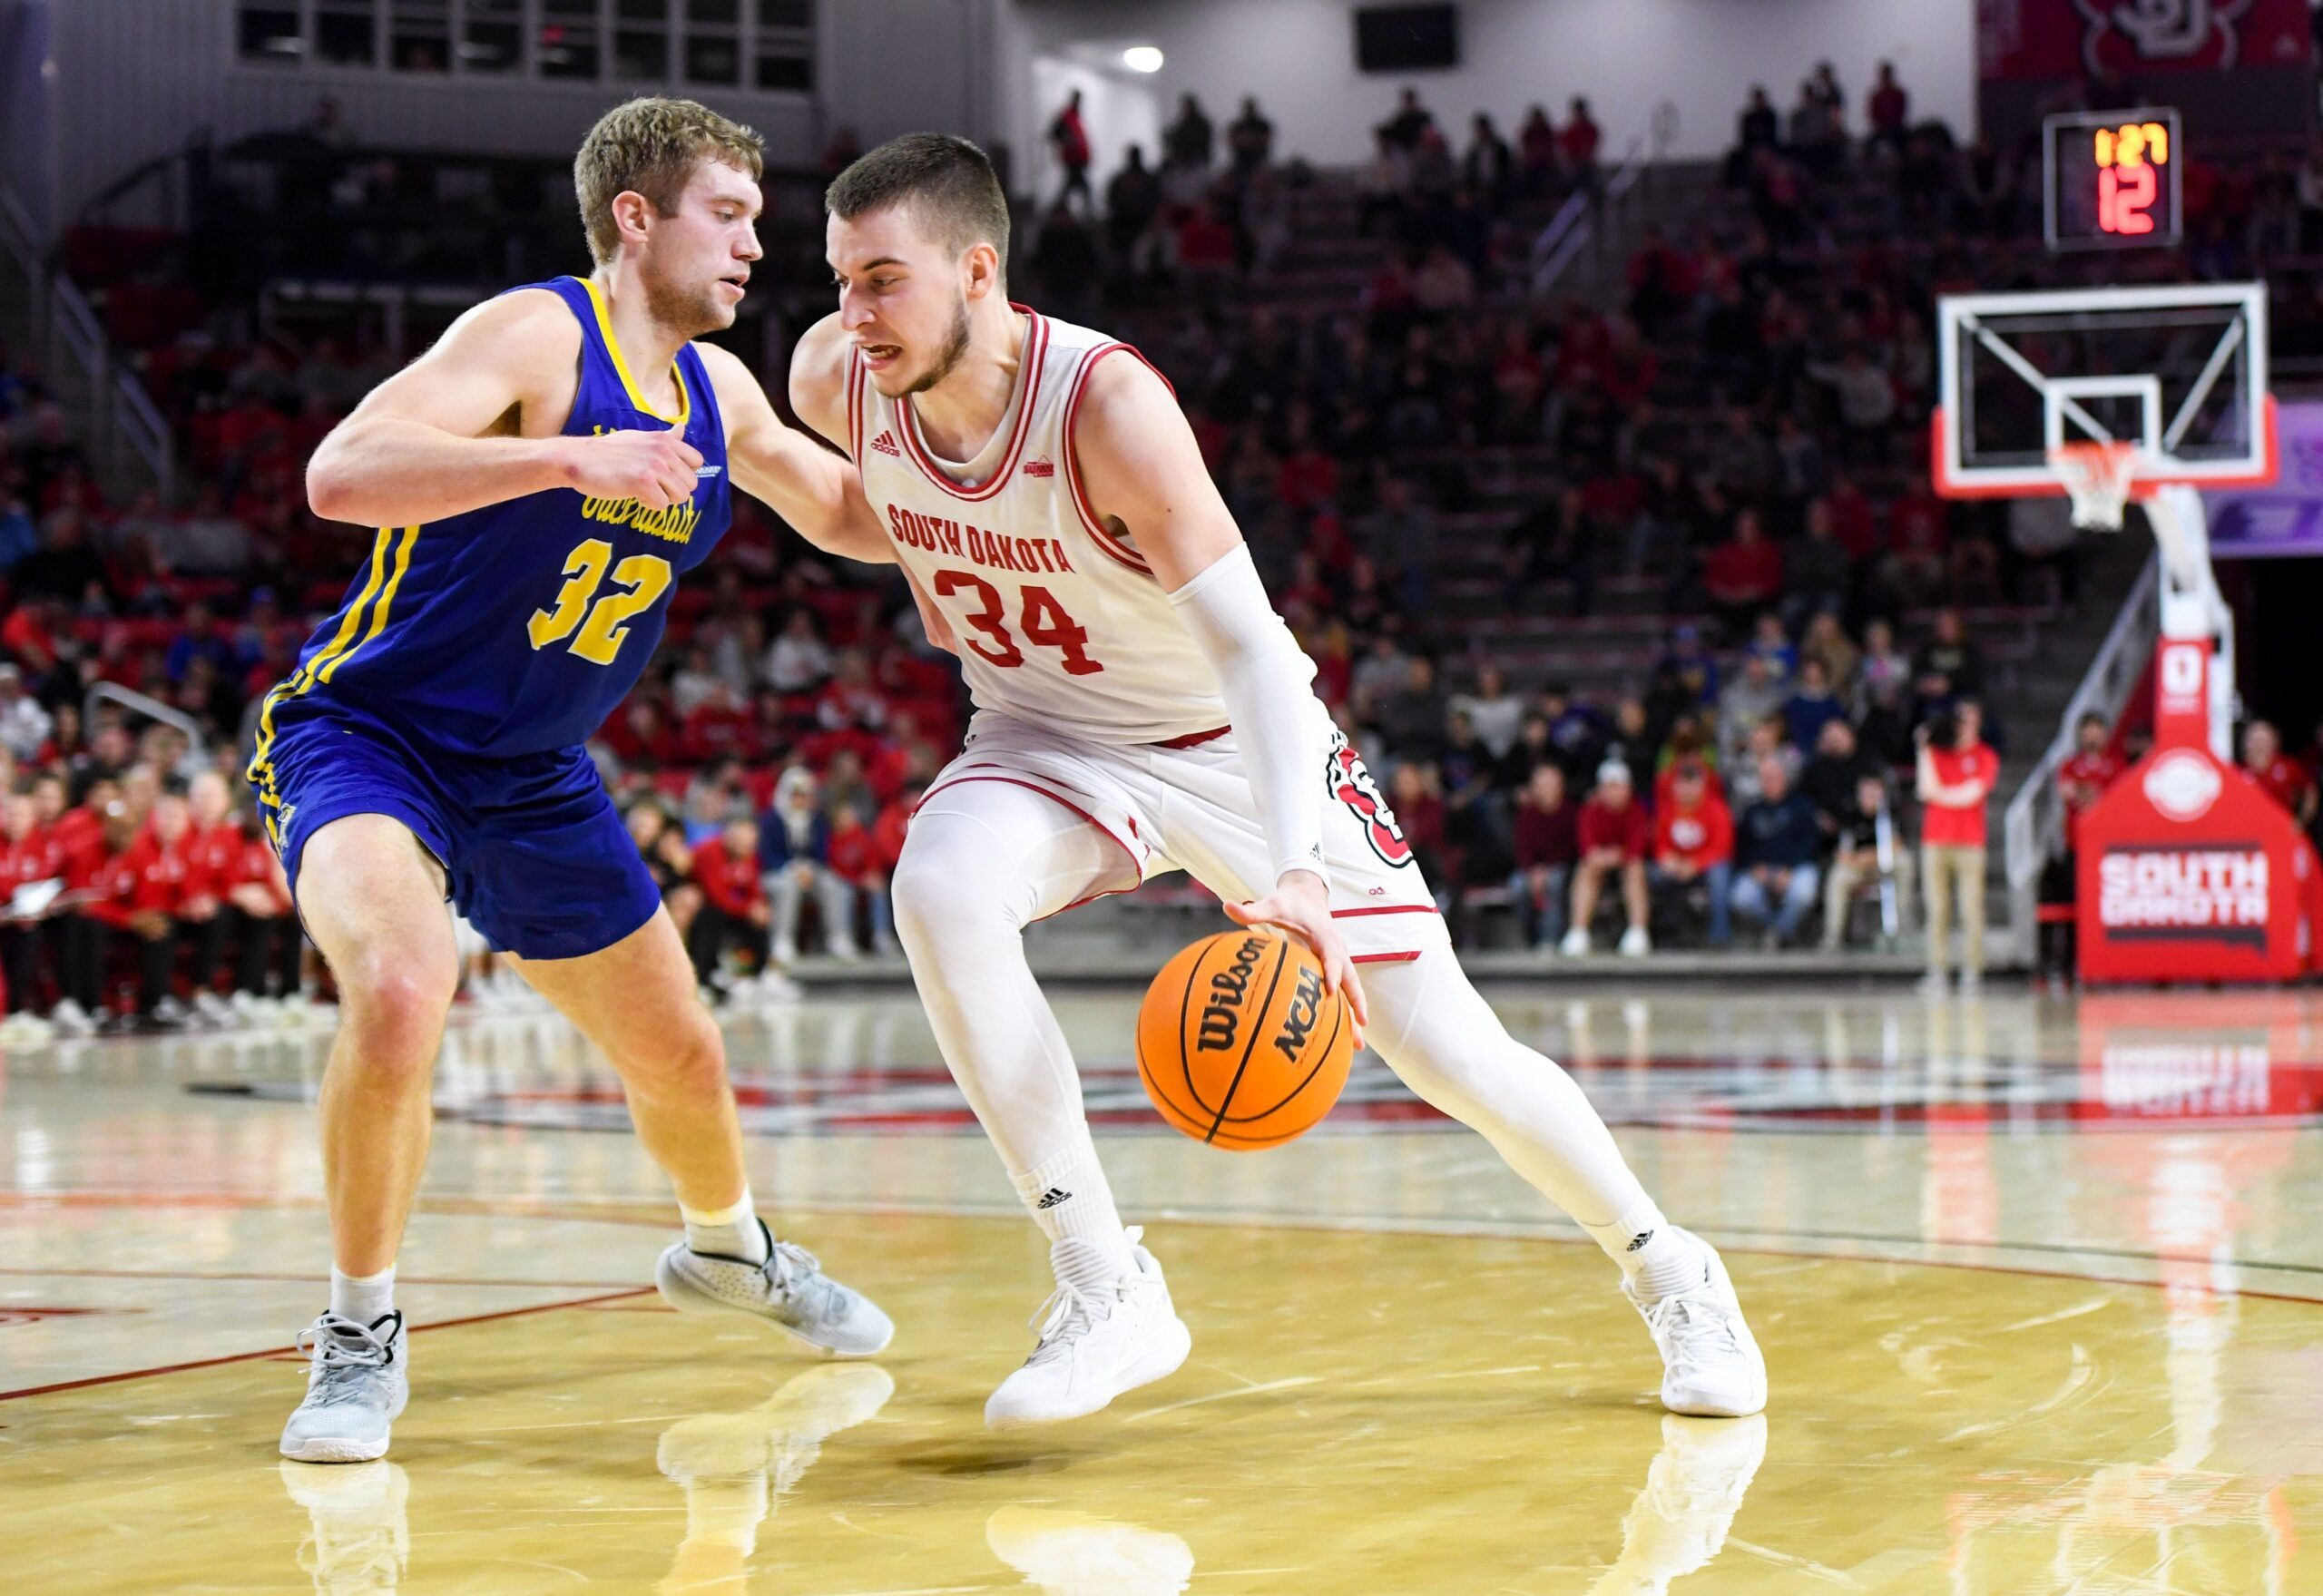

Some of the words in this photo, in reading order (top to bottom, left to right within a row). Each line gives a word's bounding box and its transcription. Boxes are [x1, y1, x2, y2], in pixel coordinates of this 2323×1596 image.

[2099, 163, 2156, 233] 12
[870, 442, 900, 457] adidas
[887, 503, 966, 559] SOUTH
[965, 524, 1077, 574] DAKOTA
[526, 538, 671, 665] 32
[934, 569, 1104, 675] 34
[2100, 851, 2269, 894] SOUTH
[2100, 891, 2269, 926] DAKOTA
[1197, 936, 1270, 1053] Wilson
[1274, 963, 1324, 1064] NCAA
[1037, 1191, 1072, 1209] adidas
